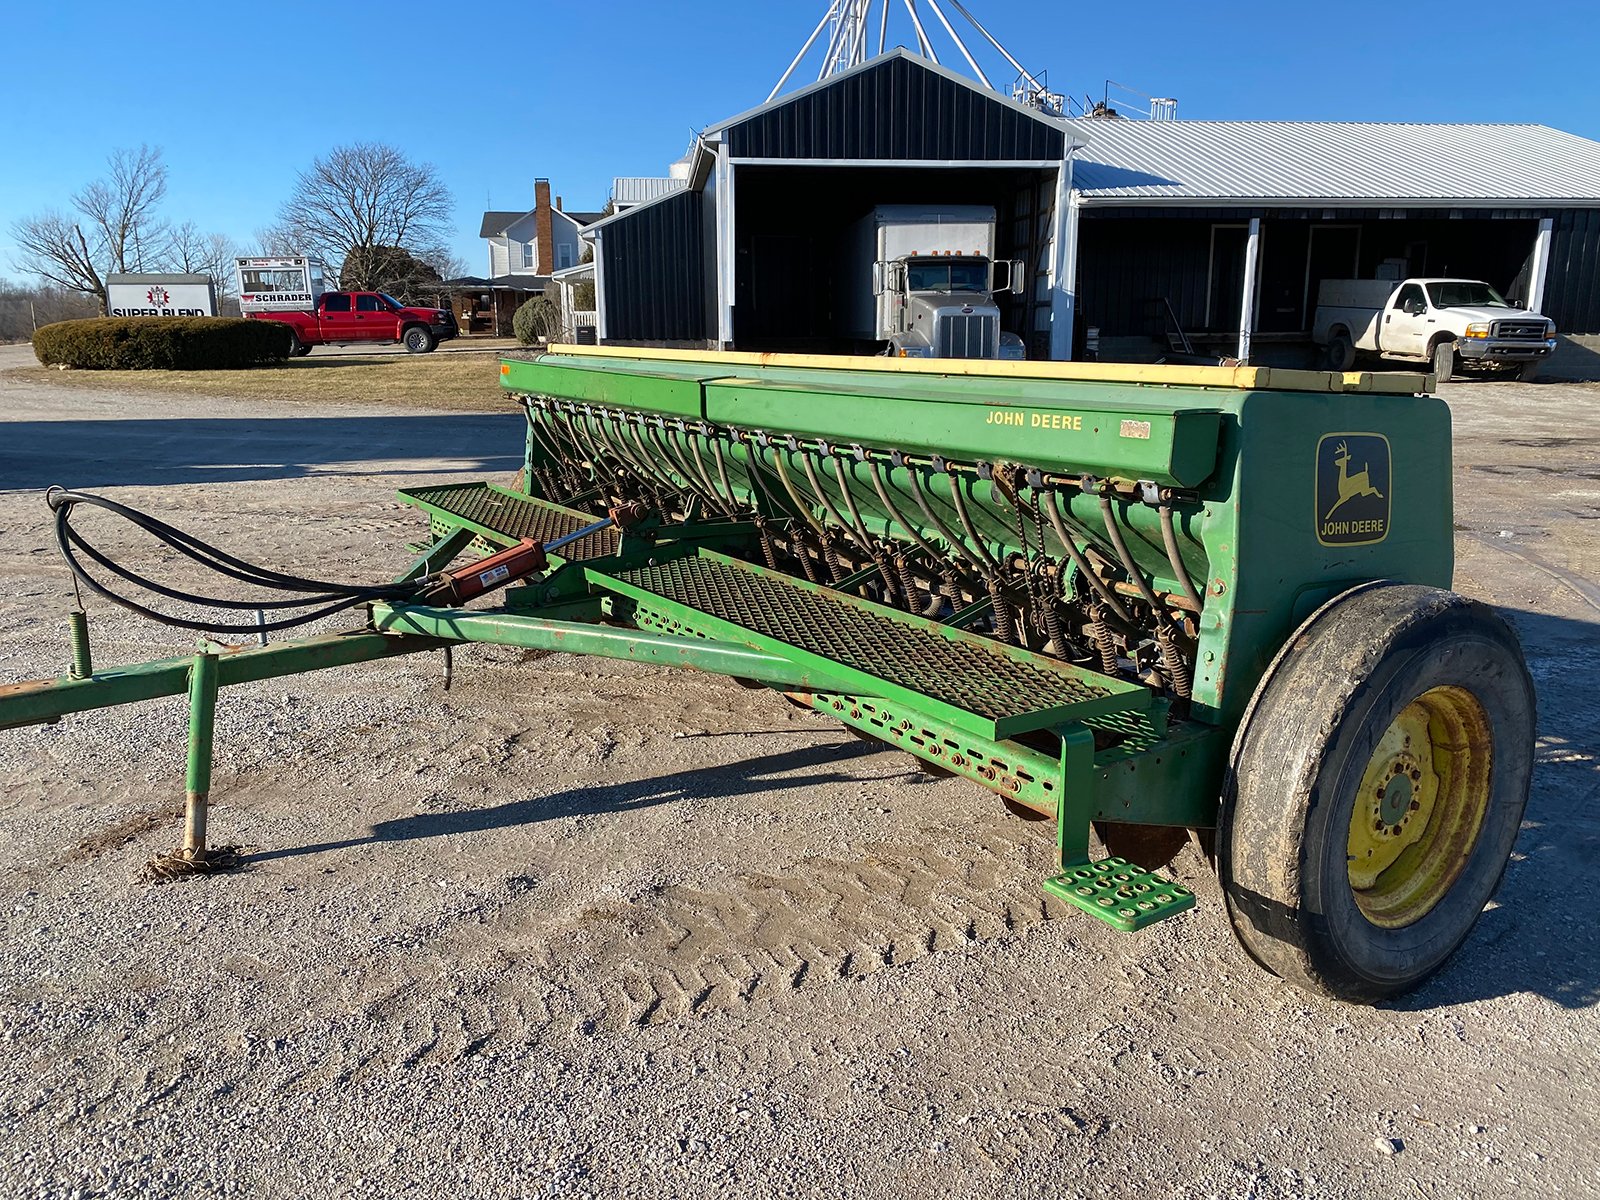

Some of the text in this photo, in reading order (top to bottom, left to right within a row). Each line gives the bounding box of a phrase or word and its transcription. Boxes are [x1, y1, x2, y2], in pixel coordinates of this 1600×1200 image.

[255, 294, 312, 302] SCHRADER
[113, 308, 158, 317] SUPER
[986, 411, 1083, 431] JOHN DEERE
[1321, 519, 1384, 536] JOHN DEERE
